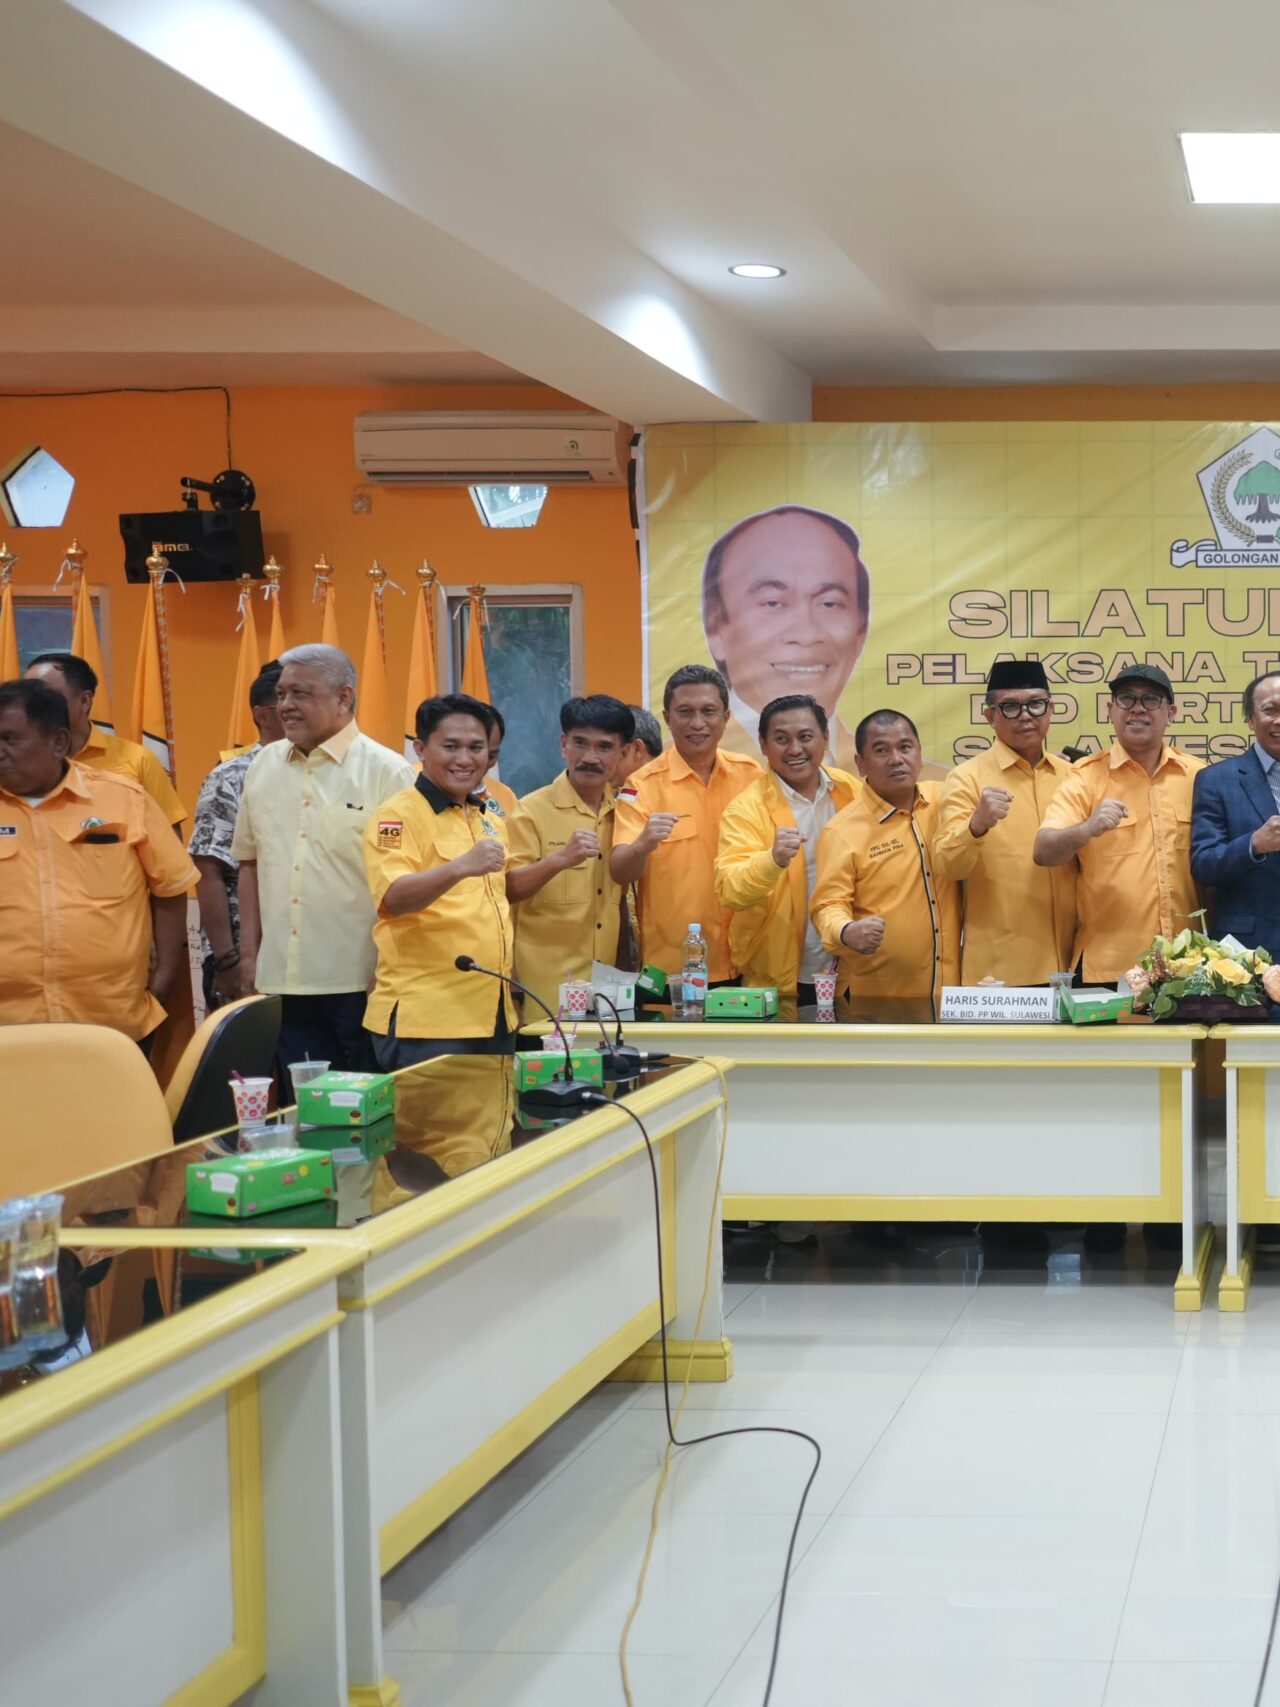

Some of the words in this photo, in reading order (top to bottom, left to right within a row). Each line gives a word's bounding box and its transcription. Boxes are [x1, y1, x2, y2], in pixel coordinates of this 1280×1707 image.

[1203, 553, 1279, 564] GOLONGAN
[379, 827, 400, 837] 4G
[945, 995, 979, 1006] HARIS
[981, 995, 1048, 1007] SURAHMAN
[941, 1010, 958, 1019] SEK.
[960, 1010, 976, 1019] BID.
[978, 1011, 988, 1019] PP
[990, 1011, 1007, 1019] WIL.
[1009, 1011, 1051, 1020] SULAWESI
